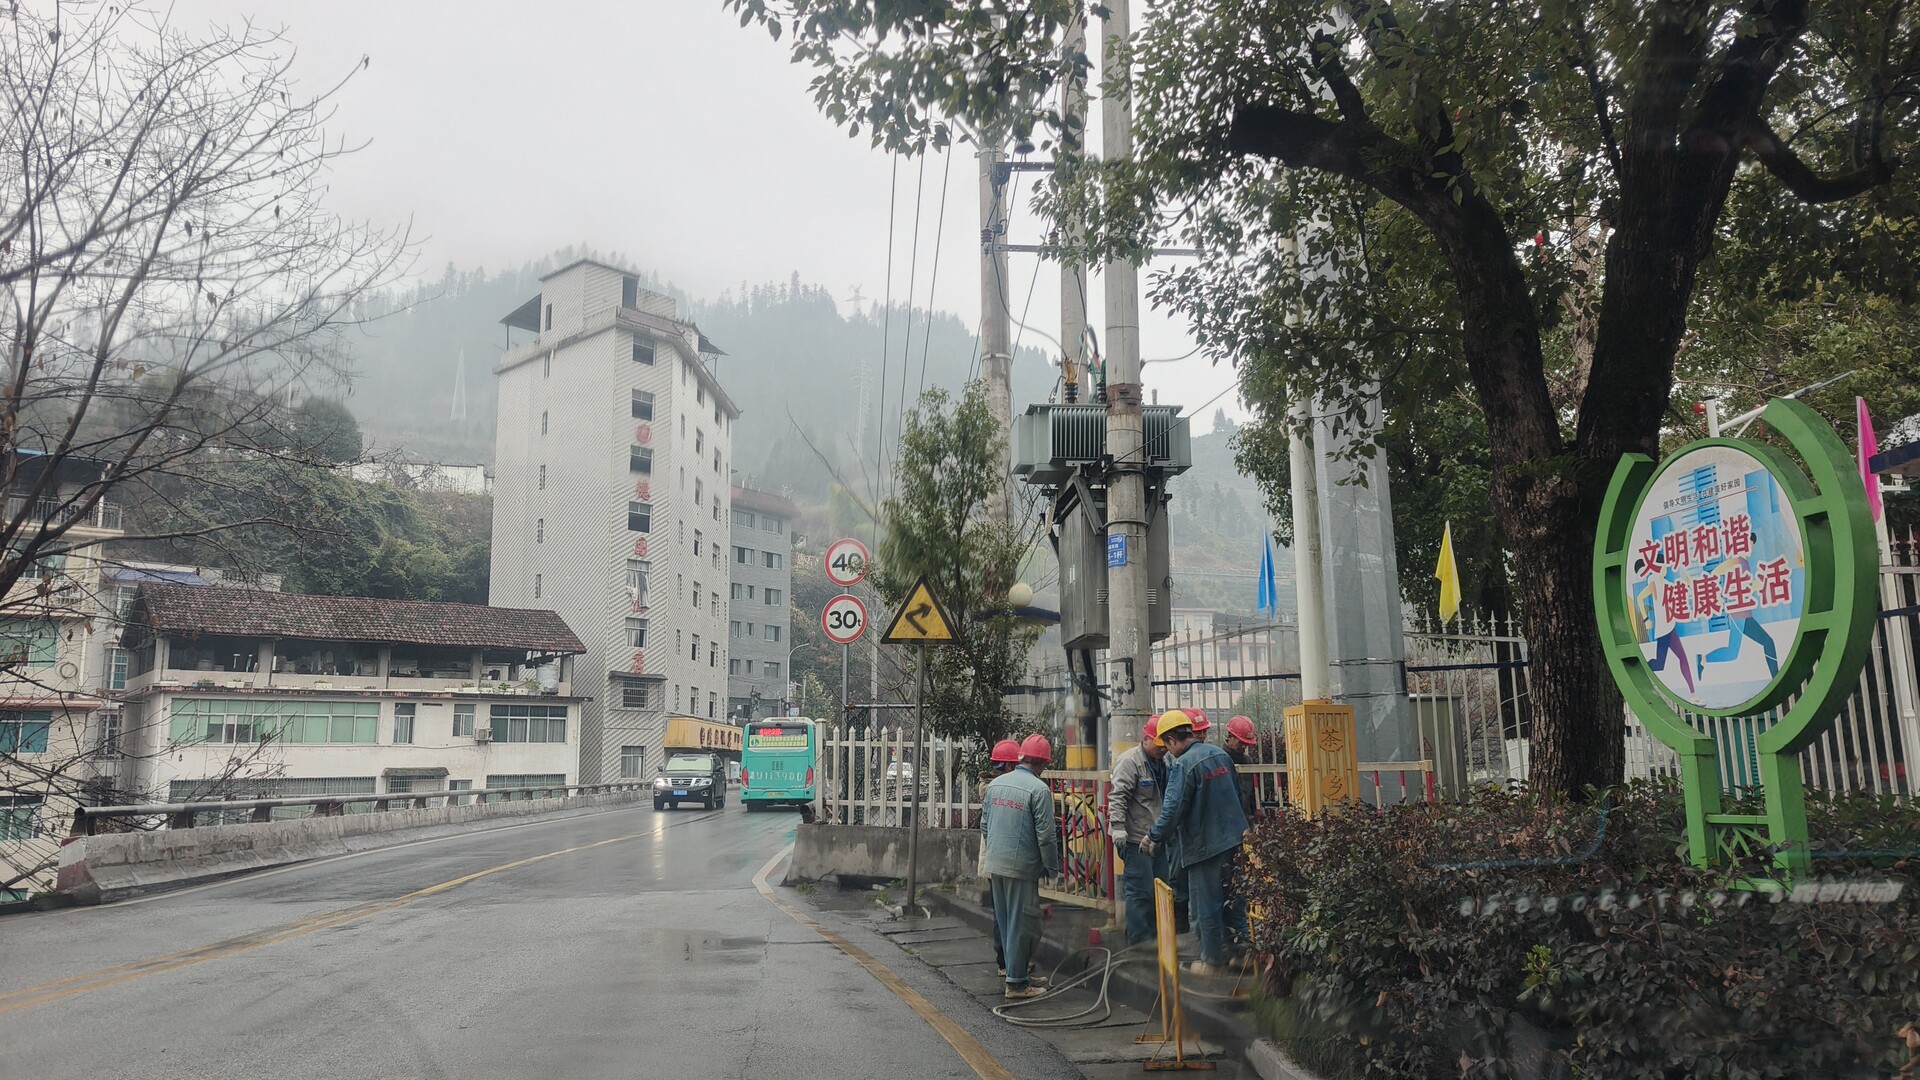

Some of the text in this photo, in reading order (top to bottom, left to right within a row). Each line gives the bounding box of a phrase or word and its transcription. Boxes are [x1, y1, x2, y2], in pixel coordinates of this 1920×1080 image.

[1638, 514, 1751, 578] 文明和谐
[829, 610, 862, 630] 30t
[1661, 557, 1789, 623] 健康生活
